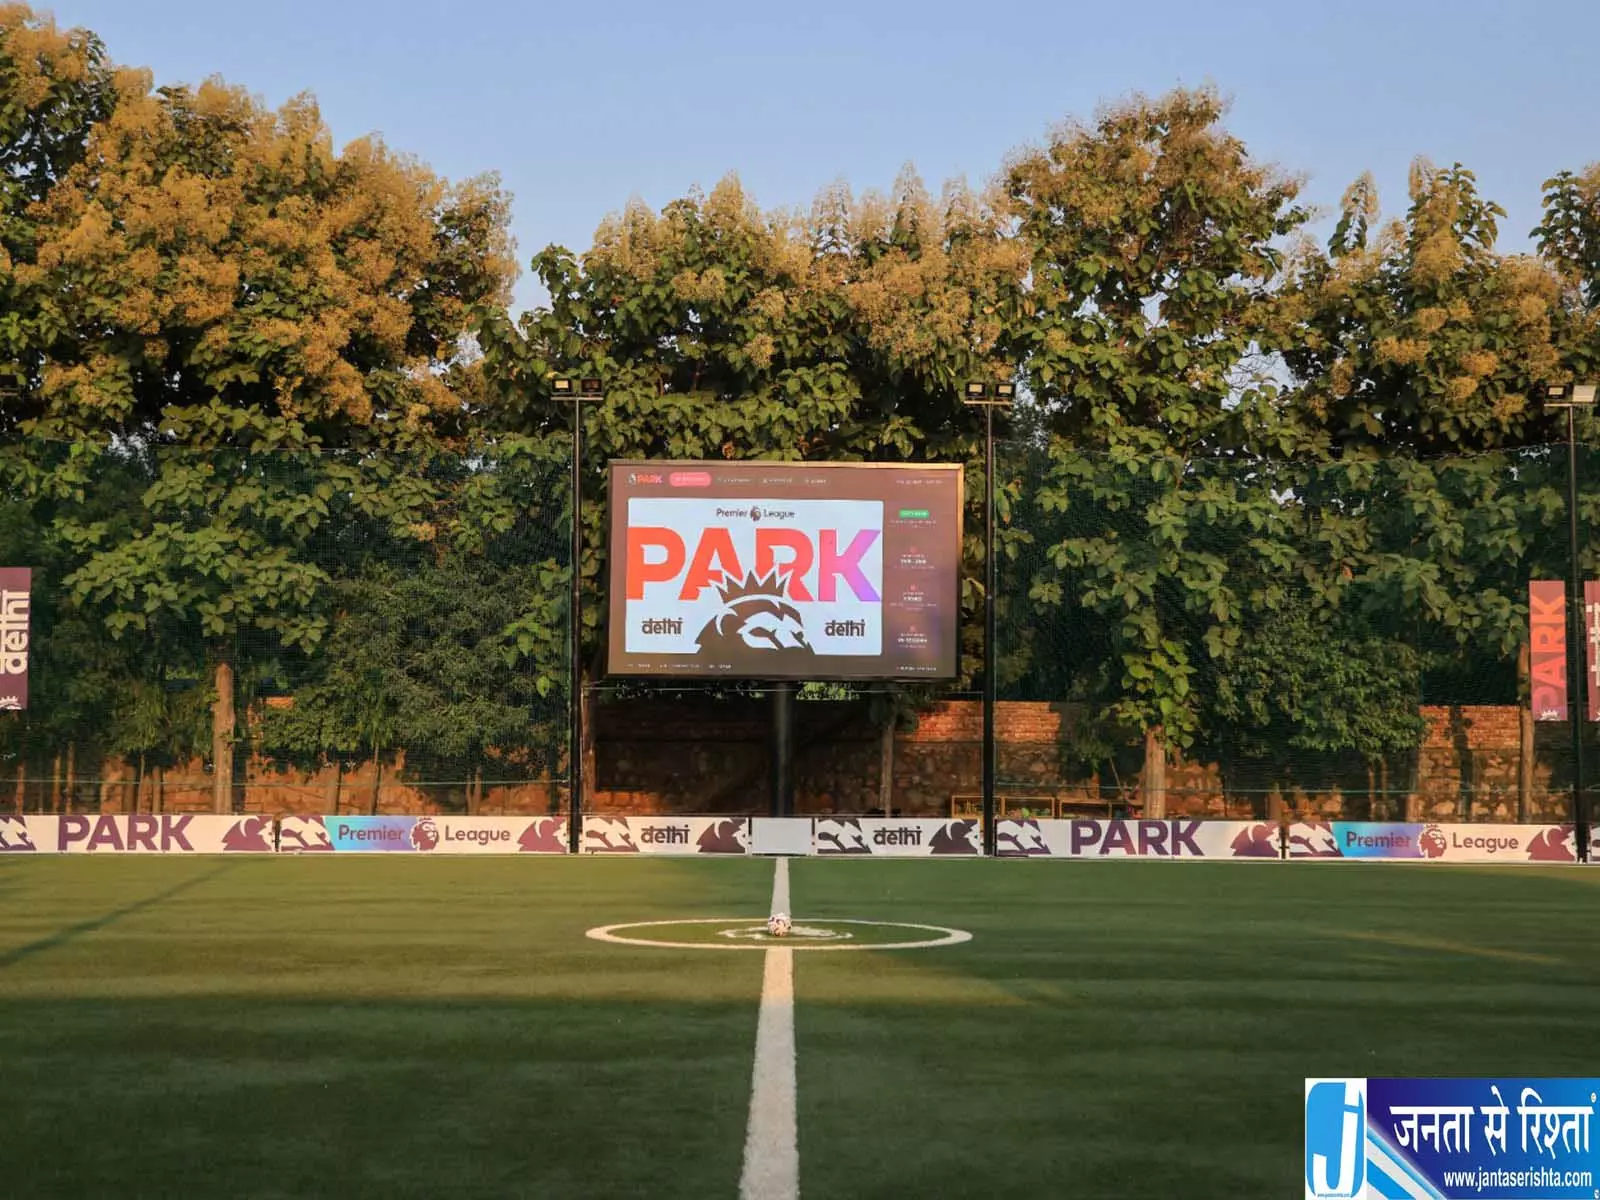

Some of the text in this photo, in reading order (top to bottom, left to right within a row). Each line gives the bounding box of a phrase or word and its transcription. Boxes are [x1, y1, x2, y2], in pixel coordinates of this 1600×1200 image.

[716, 507, 796, 519] Premier League
[626, 527, 881, 602] PARK
[641, 616, 683, 635] delhi
[824, 618, 866, 637] delhi
[1531, 593, 1566, 713] PARK
[57, 815, 195, 852] PARK
[338, 823, 511, 845] Premier League
[641, 823, 691, 845] delhi
[873, 825, 923, 847] delhi
[1070, 820, 1205, 857] PARK
[1346, 831, 1519, 853] Premier League
